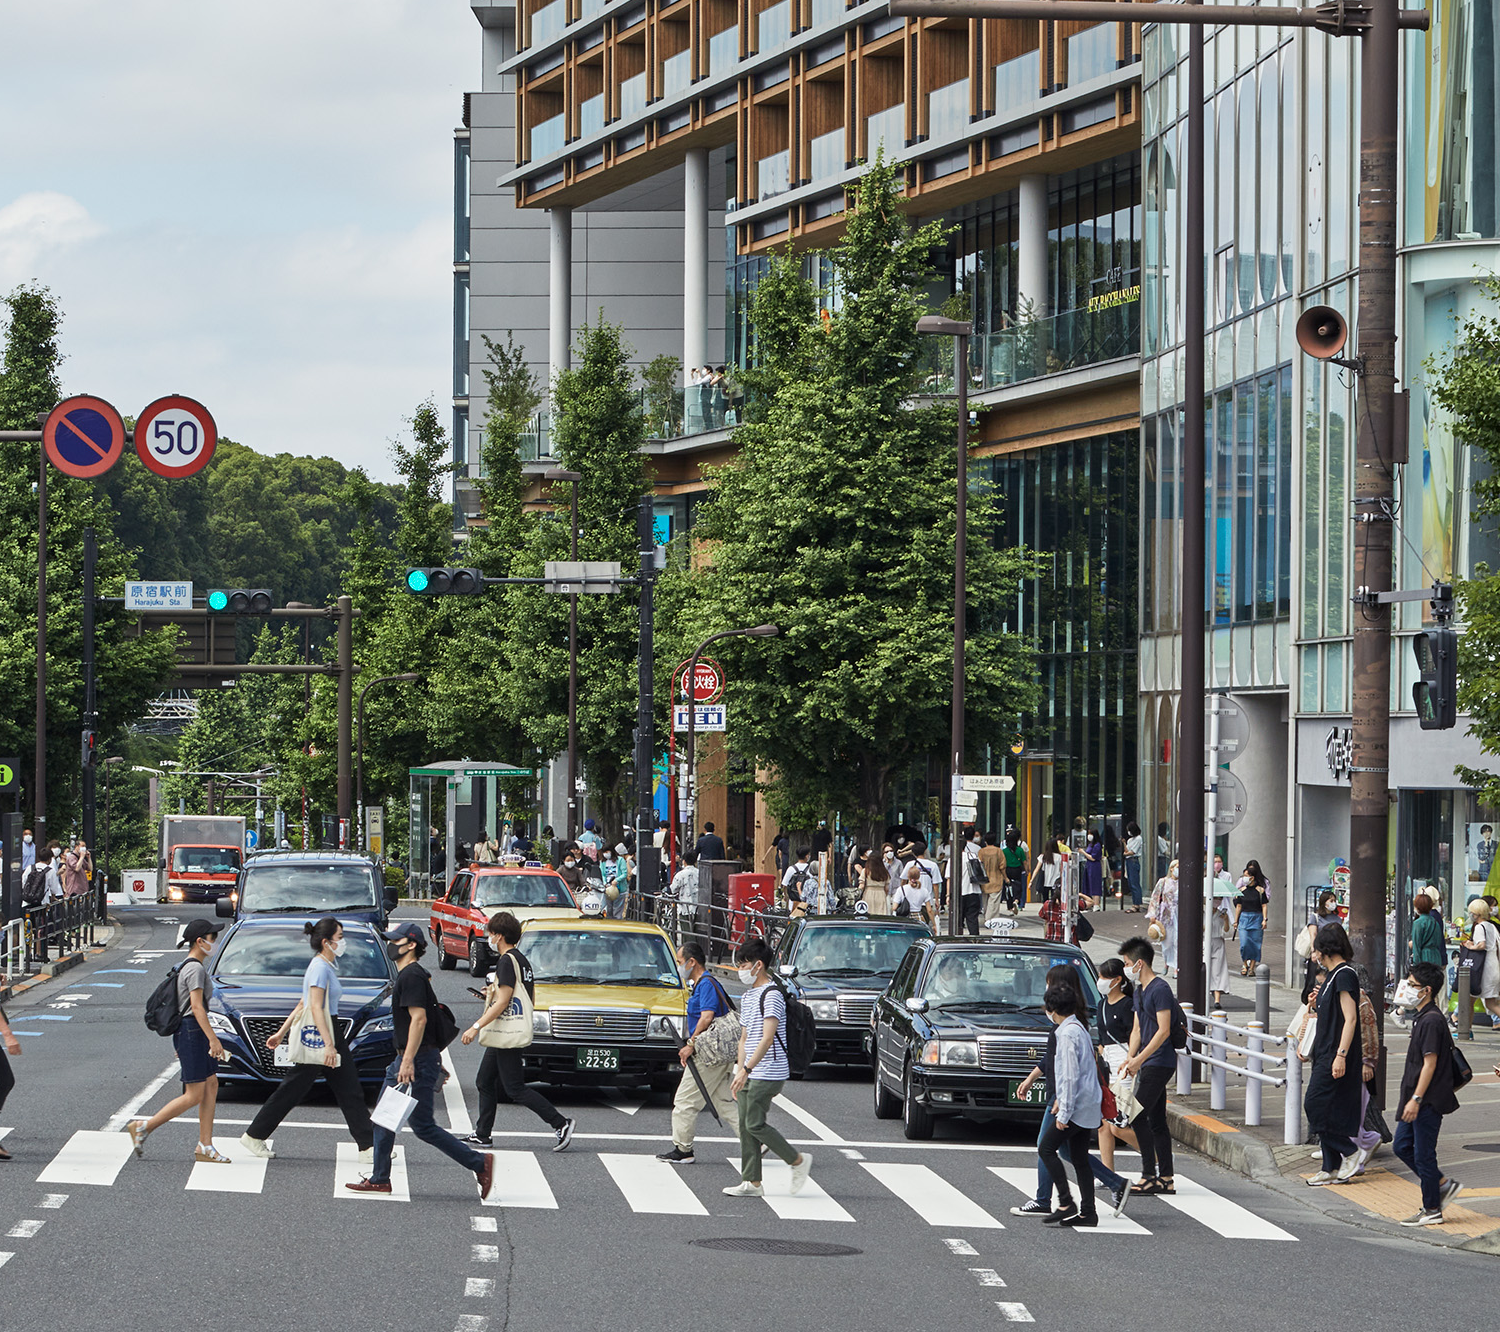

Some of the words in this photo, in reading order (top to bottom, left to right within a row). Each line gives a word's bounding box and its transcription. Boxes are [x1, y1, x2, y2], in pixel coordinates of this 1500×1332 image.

[154, 420, 198, 456] 50
[131, 585, 187, 598] 原宿駅前
[134, 599, 164, 607] Harajuku
[169, 598, 183, 606] Sta.
[991, 921, 1014, 929] グリーン
[586, 1056, 618, 1068] 22-63
